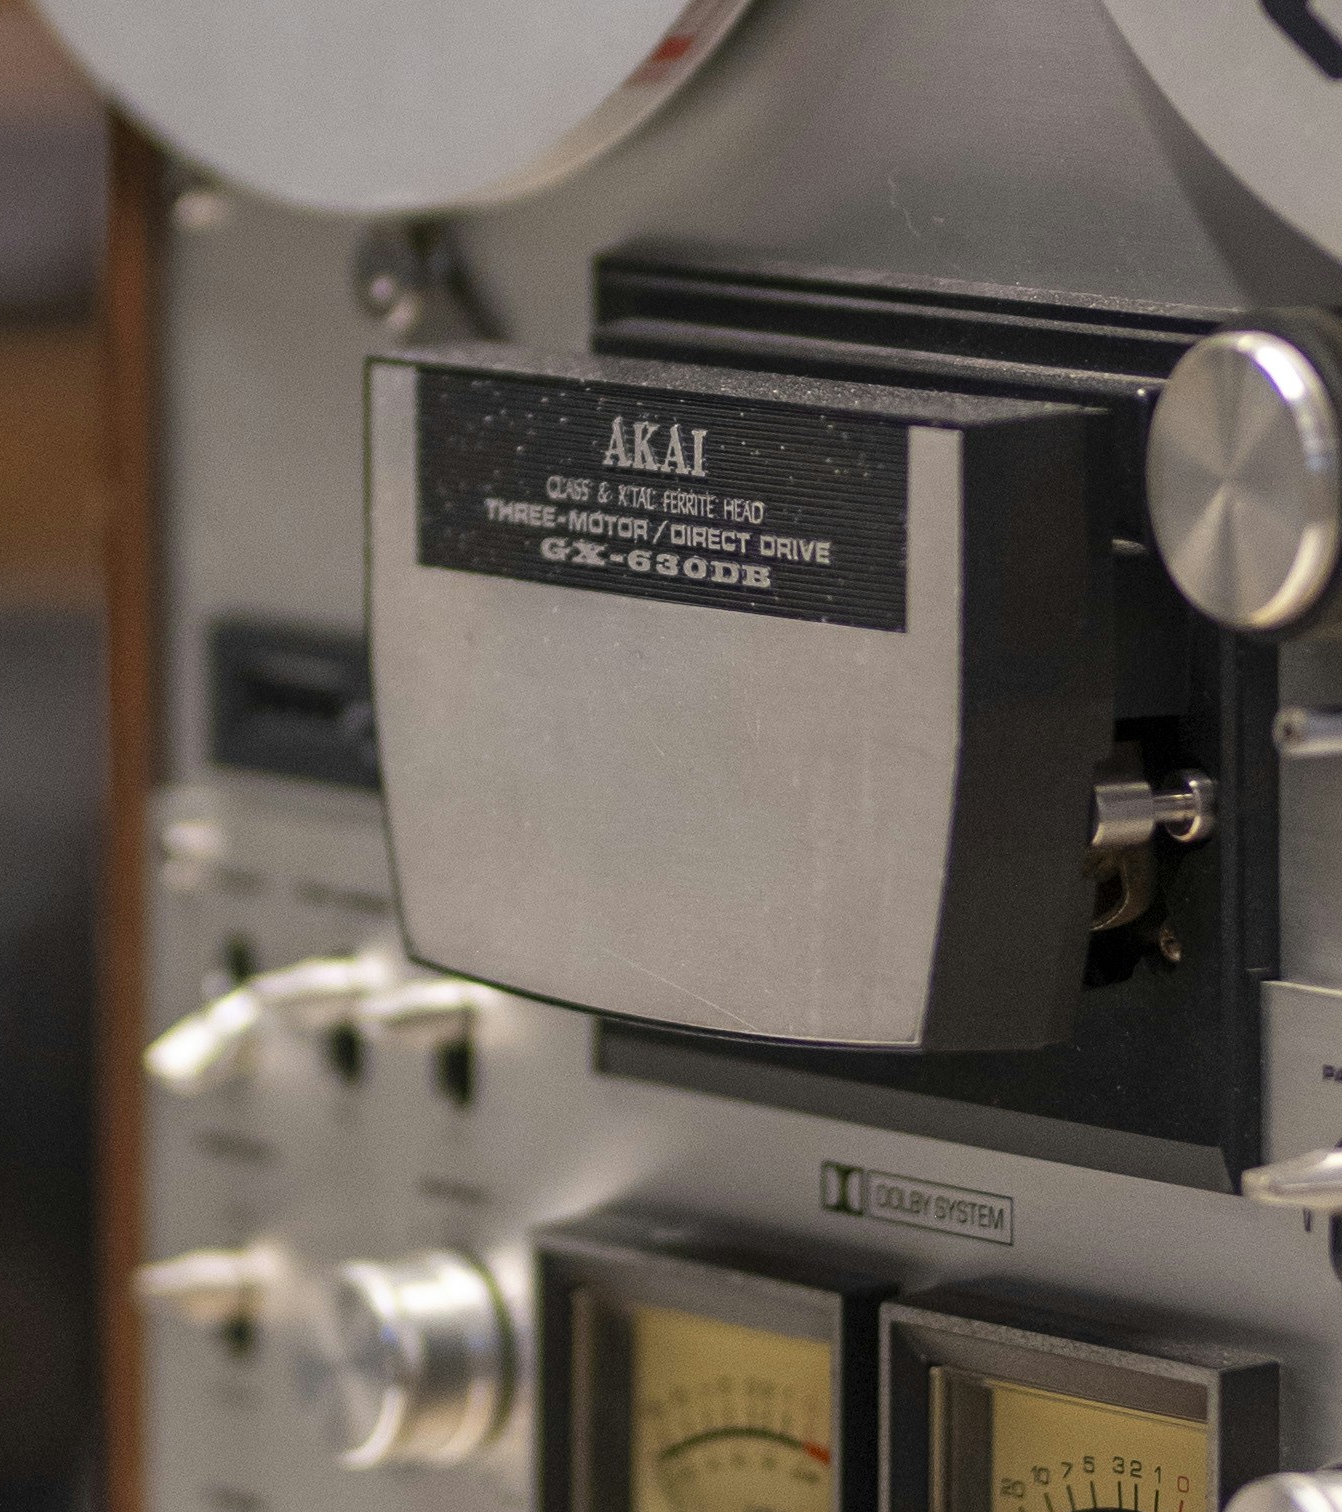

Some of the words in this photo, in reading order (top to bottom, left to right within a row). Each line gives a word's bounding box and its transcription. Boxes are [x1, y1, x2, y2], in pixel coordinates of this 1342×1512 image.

[603, 416, 708, 477] AKAI
[598, 481, 613, 503] &
[663, 490, 717, 519] FERRITE
[724, 498, 765, 524] HEAD
[541, 537, 772, 589] GX-630DB
[760, 534, 831, 565] DRIVE
[876, 1184, 930, 1215] DOLBY
[934, 1195, 1005, 1230] SYSTEM
[1032, 1465, 1051, 1485] 10
[1061, 1462, 1073, 1478] 7
[1083, 1456, 1096, 1474] 5
[1112, 1456, 1125, 1474] 3
[1130, 1460, 1143, 1478] 2
[1154, 1466, 1162, 1484] 1
[1177, 1476, 1190, 1494] 0
